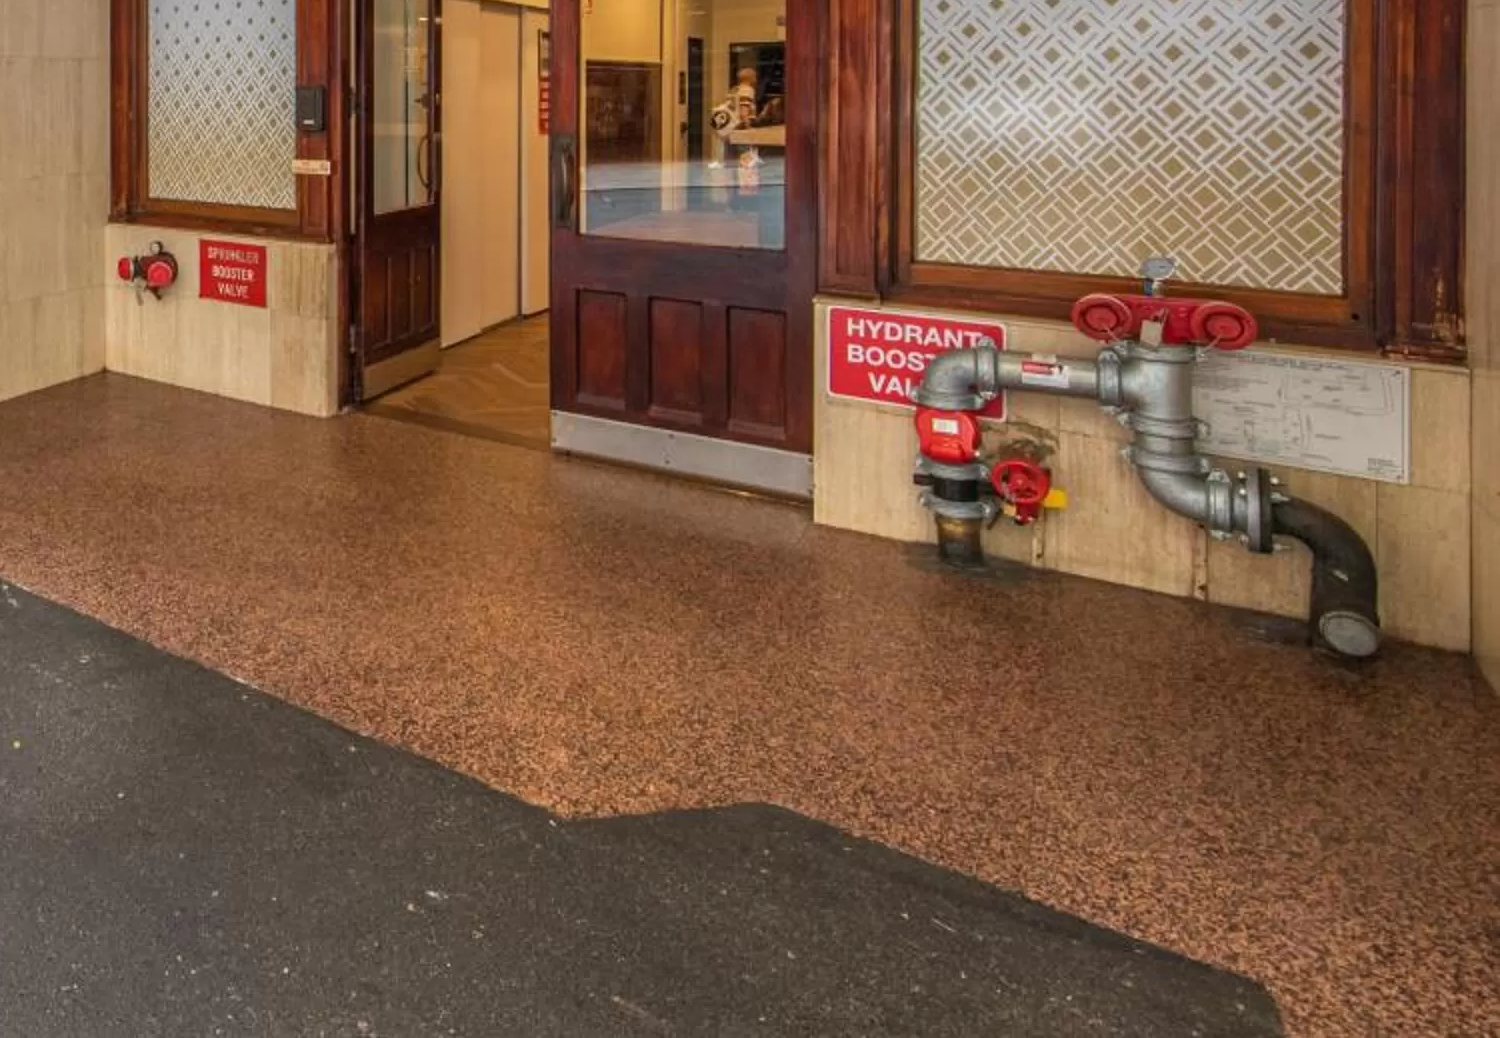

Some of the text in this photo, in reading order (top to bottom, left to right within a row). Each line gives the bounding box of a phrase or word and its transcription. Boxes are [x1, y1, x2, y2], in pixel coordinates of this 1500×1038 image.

[211, 265, 255, 282] BOOSTER
[217, 282, 249, 298] VALVE
[846, 317, 983, 349] HYDRANT
[846, 343, 937, 372] BOOS
